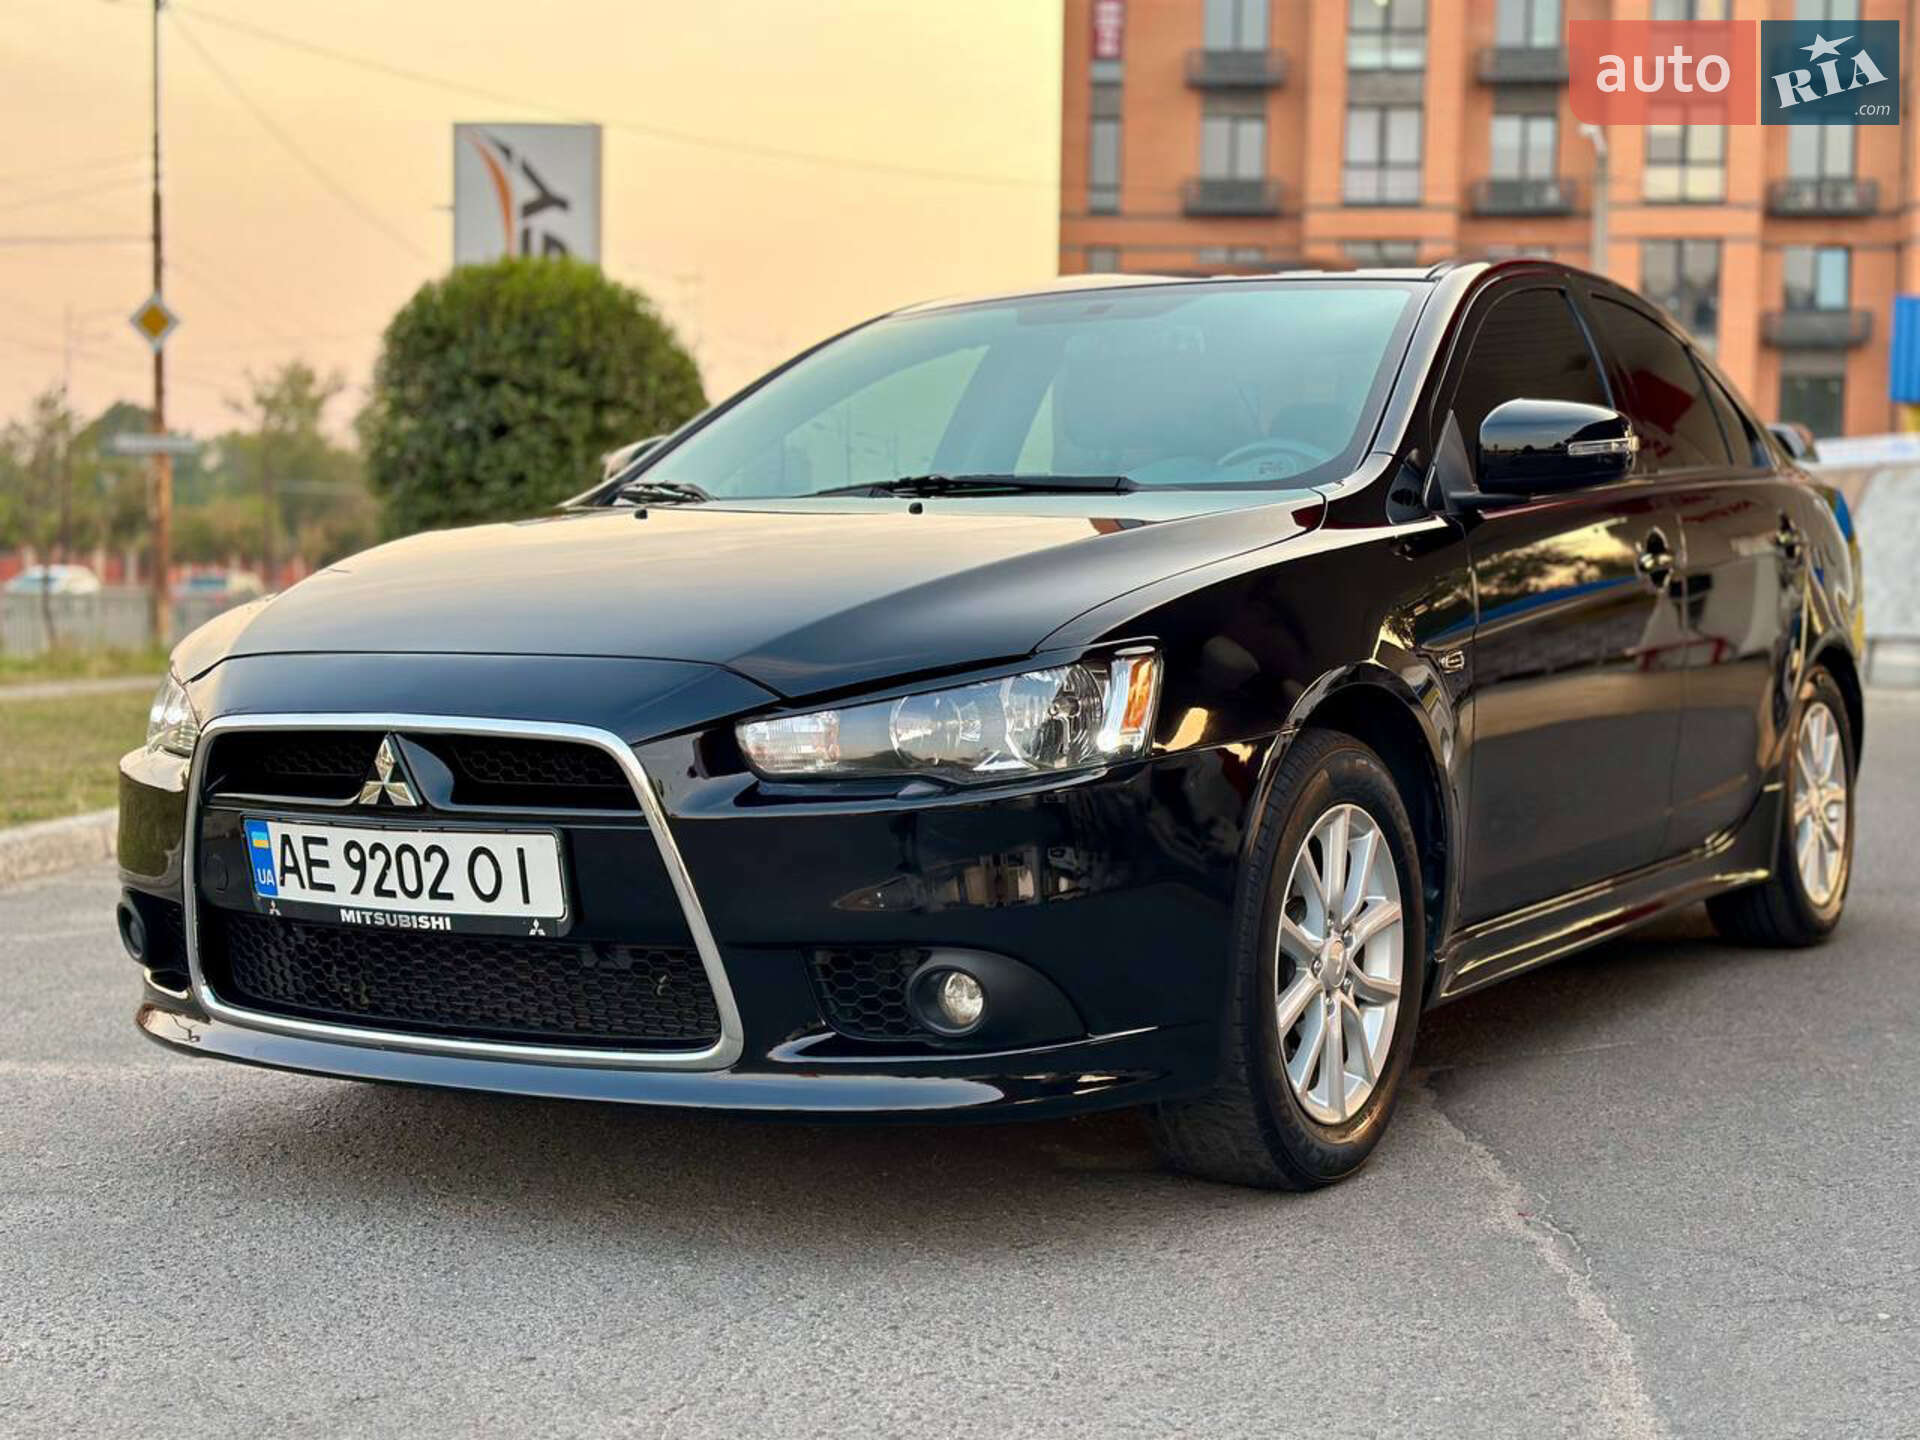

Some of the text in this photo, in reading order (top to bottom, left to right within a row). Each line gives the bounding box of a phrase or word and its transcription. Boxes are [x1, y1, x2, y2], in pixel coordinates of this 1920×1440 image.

[256, 868, 276, 887] UA
[279, 833, 336, 892] AE
[343, 840, 455, 901] 9202
[339, 908, 452, 932] MITSUBISHI
